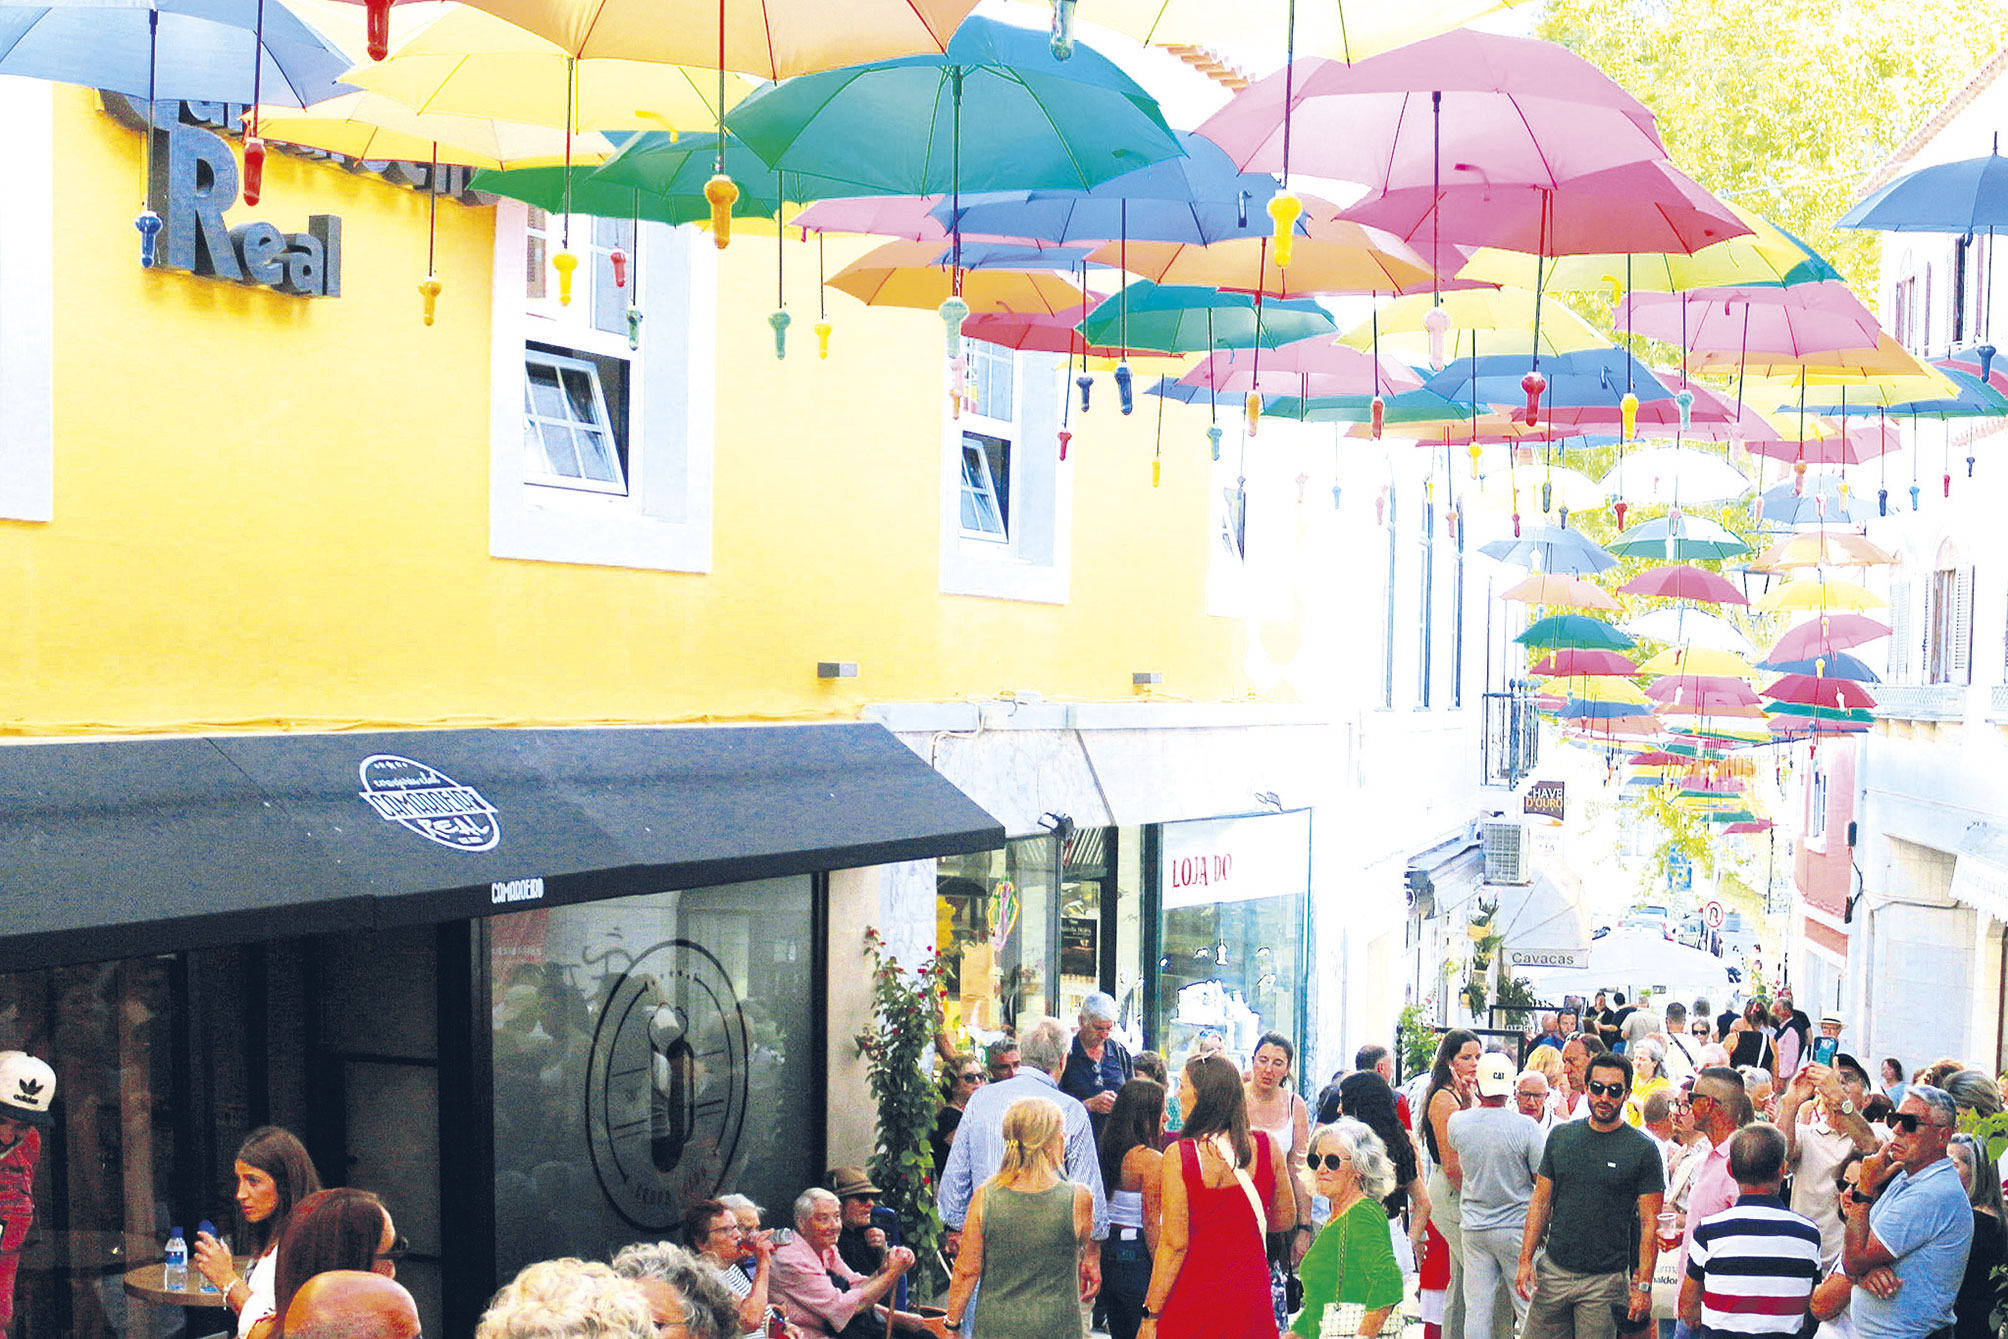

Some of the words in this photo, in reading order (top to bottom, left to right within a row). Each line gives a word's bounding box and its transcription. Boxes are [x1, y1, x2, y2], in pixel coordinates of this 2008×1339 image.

[154, 122, 341, 298] Real
[416, 814, 489, 838] REAL
[1172, 856, 1208, 888] LOJA
[1213, 853, 1232, 882] DO
[1511, 952, 1575, 965] Cavacas
[13, 1093, 39, 1105] adidas
